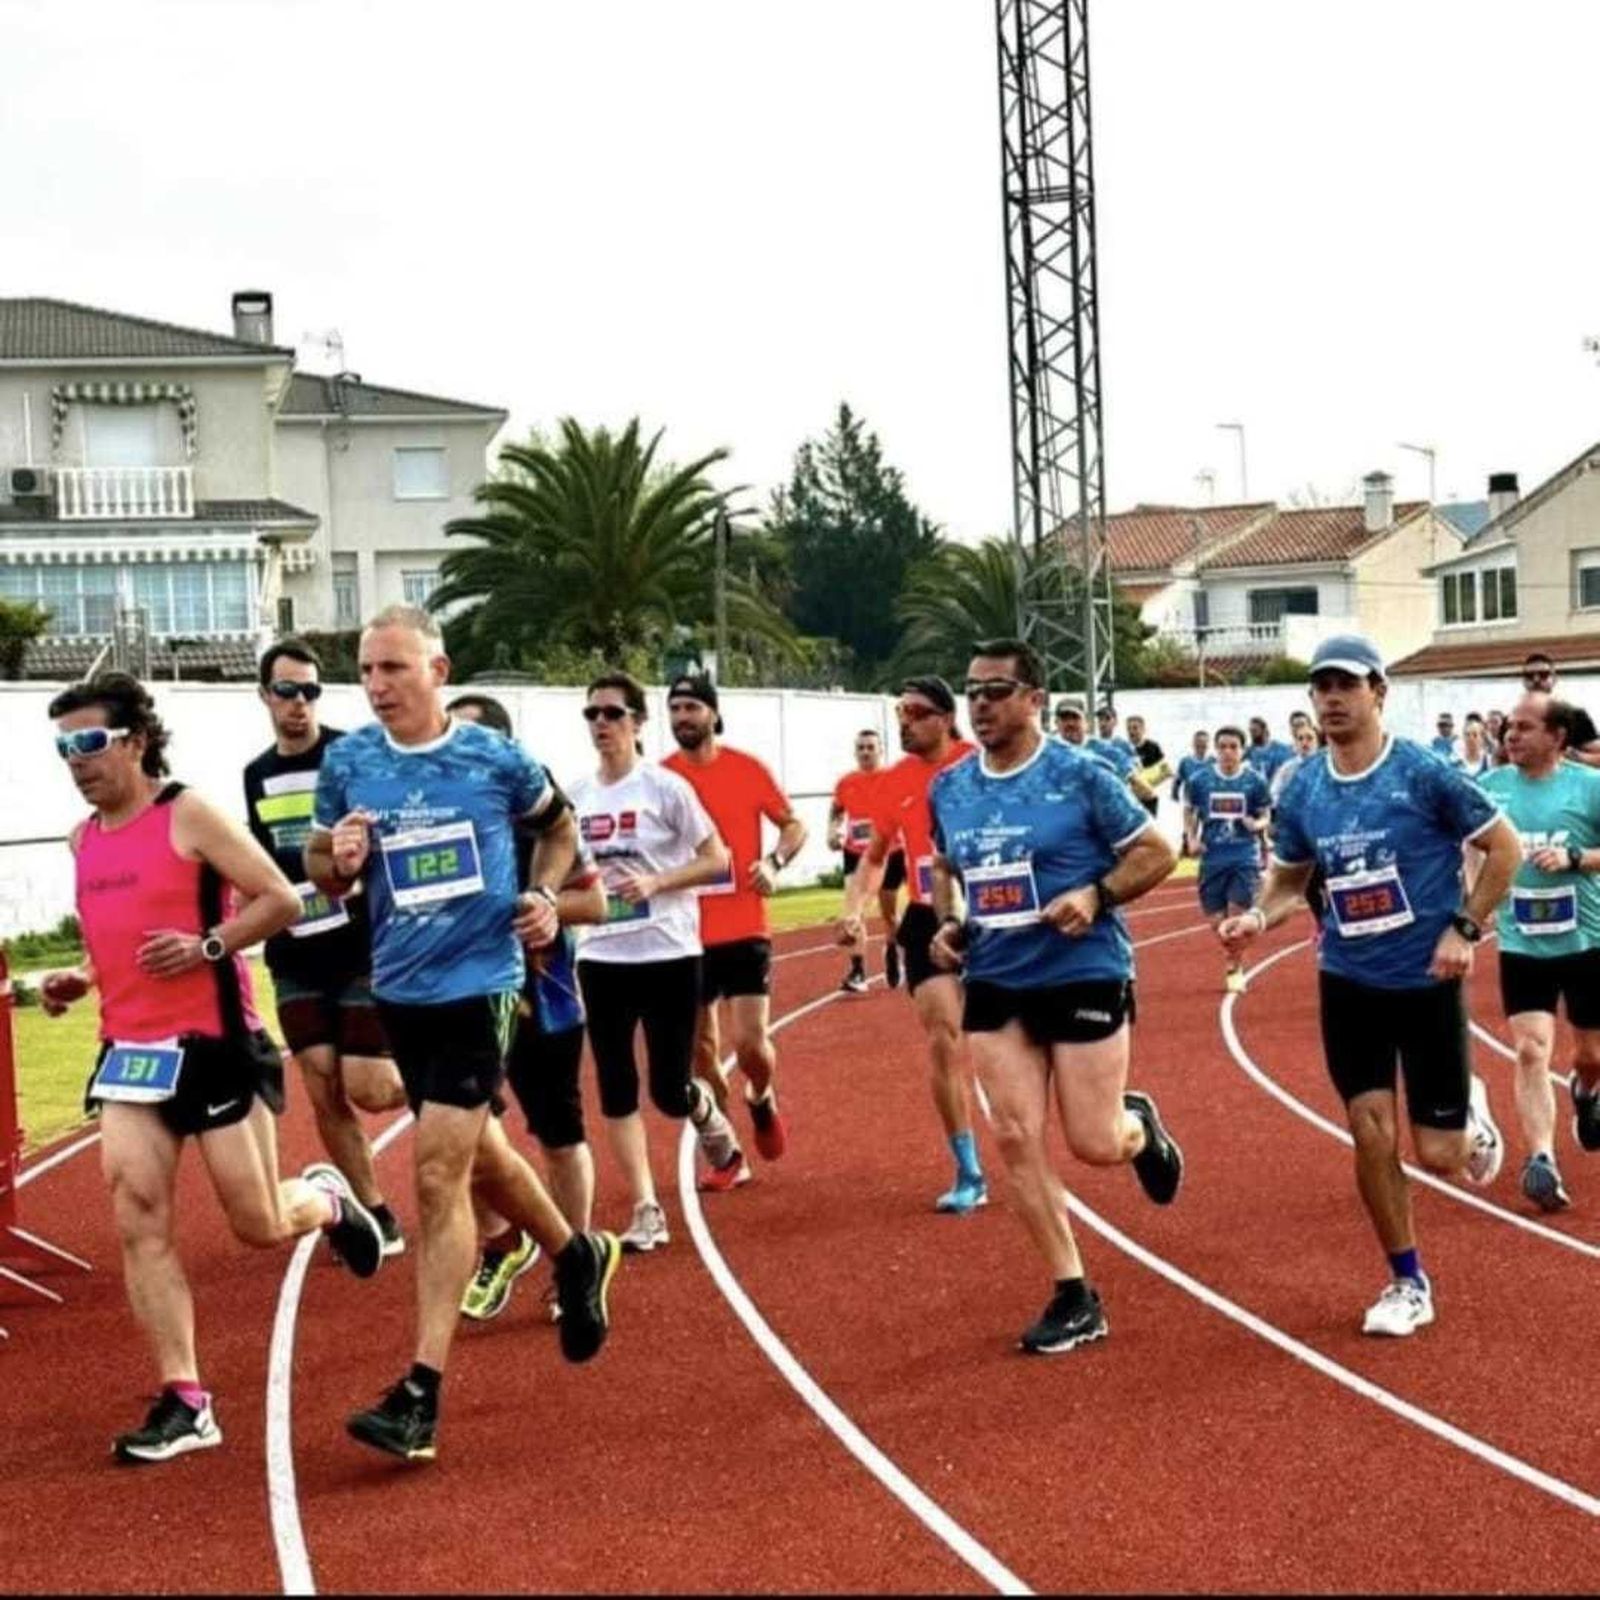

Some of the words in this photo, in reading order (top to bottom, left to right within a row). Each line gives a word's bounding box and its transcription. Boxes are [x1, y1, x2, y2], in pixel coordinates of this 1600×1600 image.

[408, 847, 459, 881] 122
[977, 883, 1022, 911] 254
[1345, 887, 1393, 917] 253
[121, 1055, 161, 1082] 131
